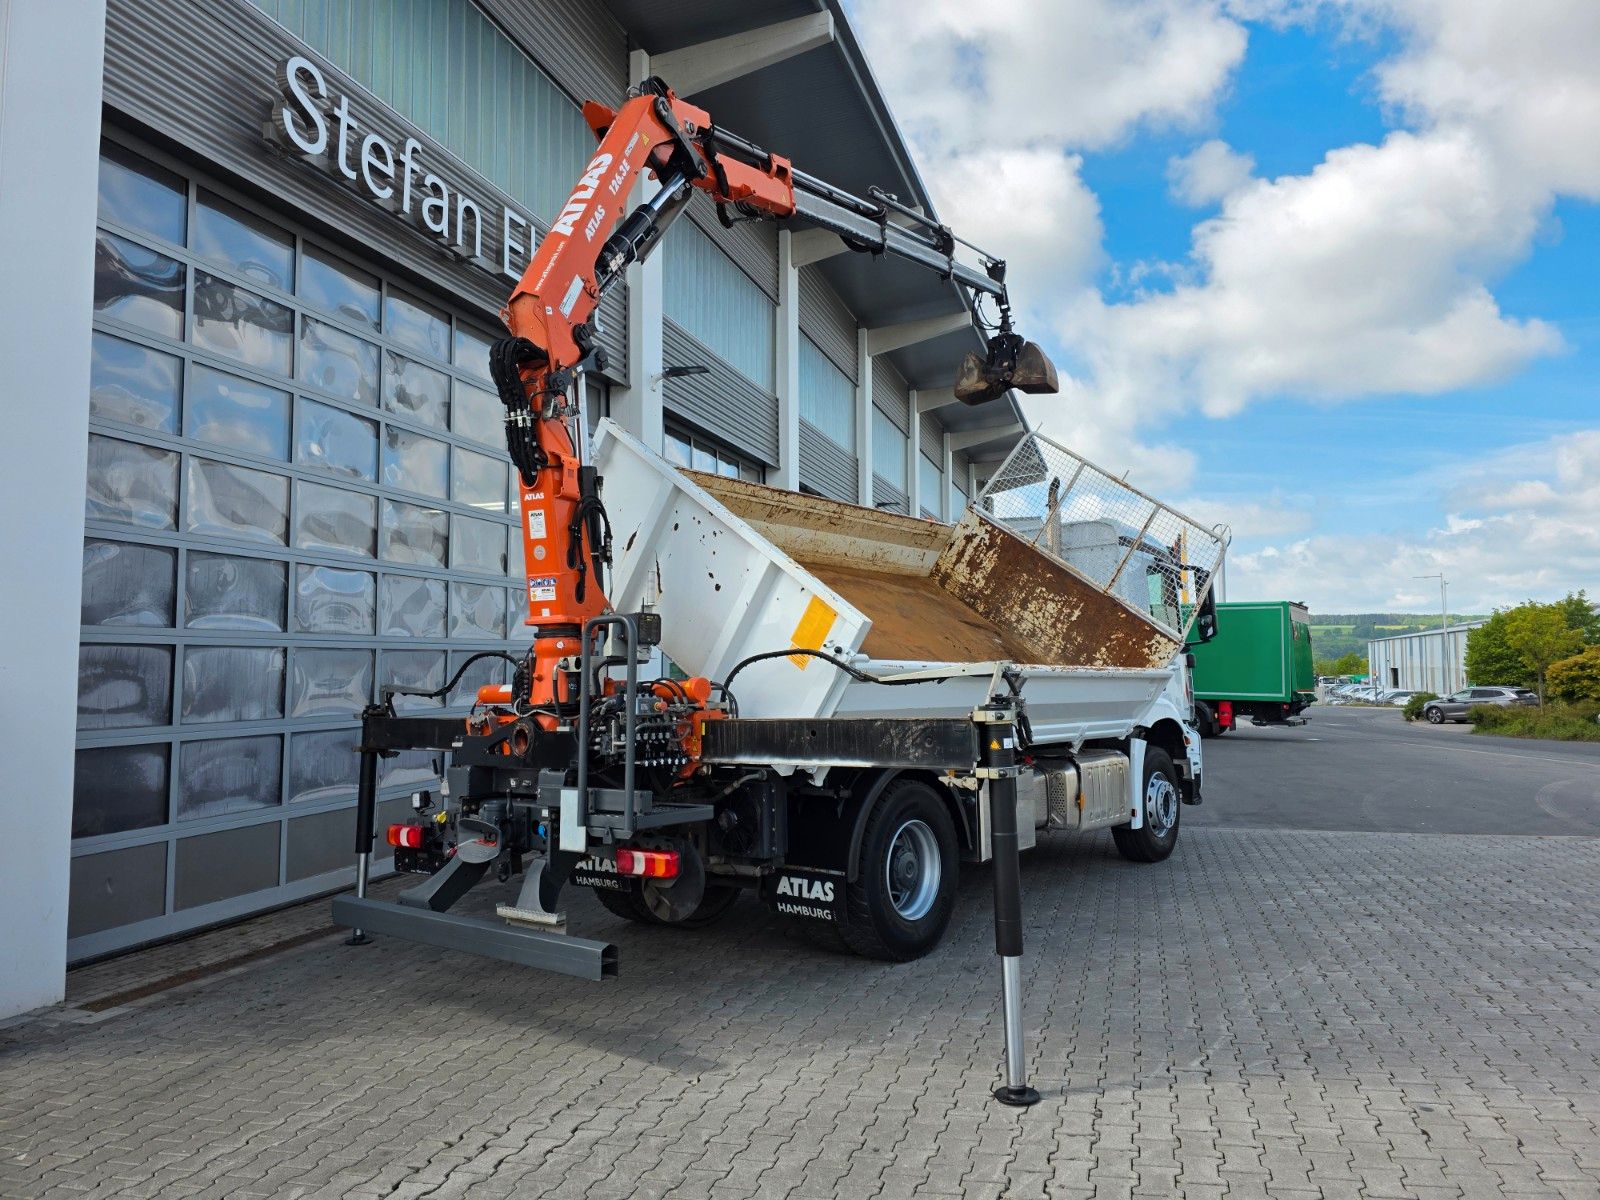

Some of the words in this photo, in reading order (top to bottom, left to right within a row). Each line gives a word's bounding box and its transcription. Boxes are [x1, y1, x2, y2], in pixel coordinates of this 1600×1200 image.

[283, 56, 482, 258] Stefan
[551, 153, 613, 236] ATLAS
[584, 204, 606, 243] ATLAS
[524, 492, 545, 501] ATLAS
[576, 875, 619, 888] HAMBURG
[776, 875, 835, 903] ATLAS
[777, 902, 832, 920] HAMBURG
